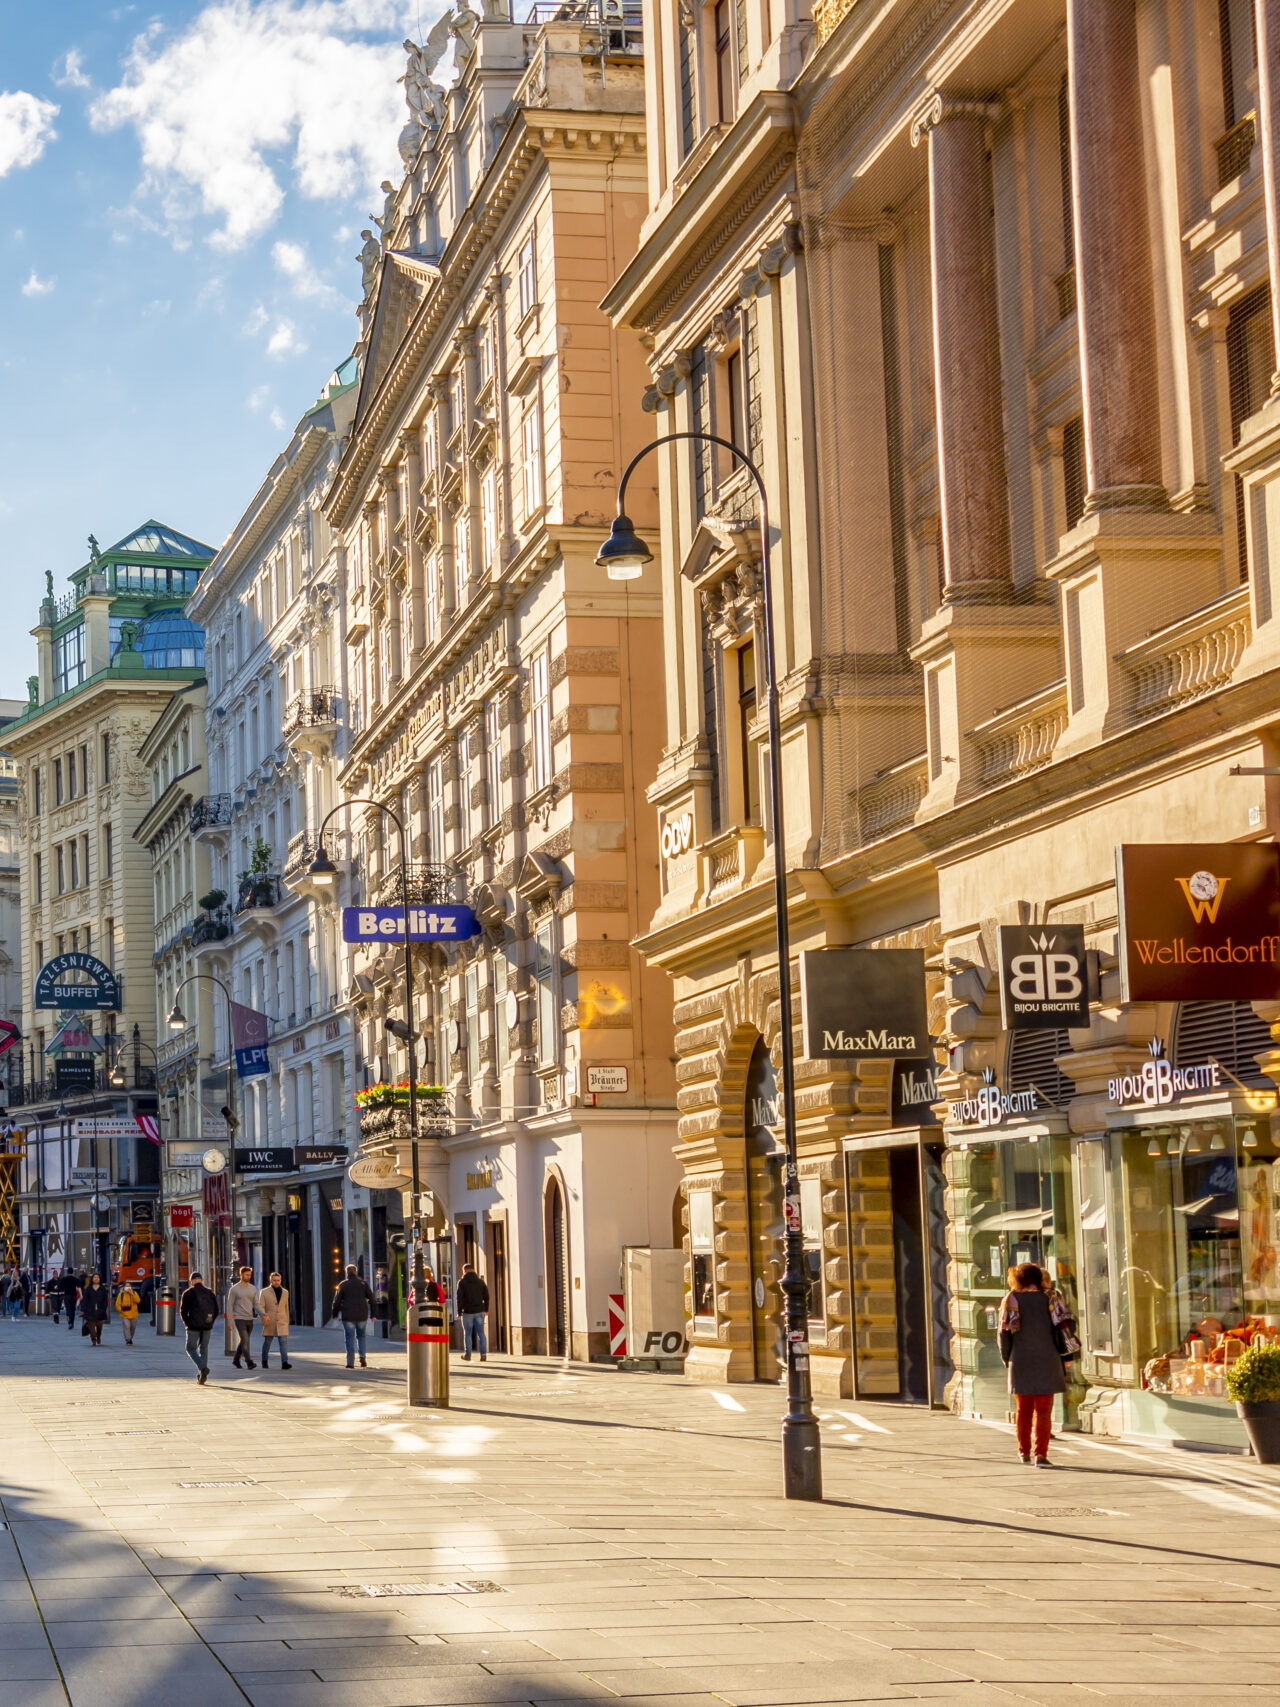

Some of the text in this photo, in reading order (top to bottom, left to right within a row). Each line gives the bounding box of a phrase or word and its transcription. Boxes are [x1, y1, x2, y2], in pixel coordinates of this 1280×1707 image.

[358, 910, 457, 935] Berlitz
[1133, 936, 1280, 965] Wellendorff
[54, 987, 100, 997] BUFFET
[1014, 1002, 1080, 1014] BIJOU BRIGITTE
[822, 1029, 917, 1051] MaxMara
[1108, 1073, 1144, 1105] BIJOU
[951, 1097, 980, 1125] BIJOU
[248, 1151, 274, 1163] IWC
[172, 1207, 191, 1217] högl
